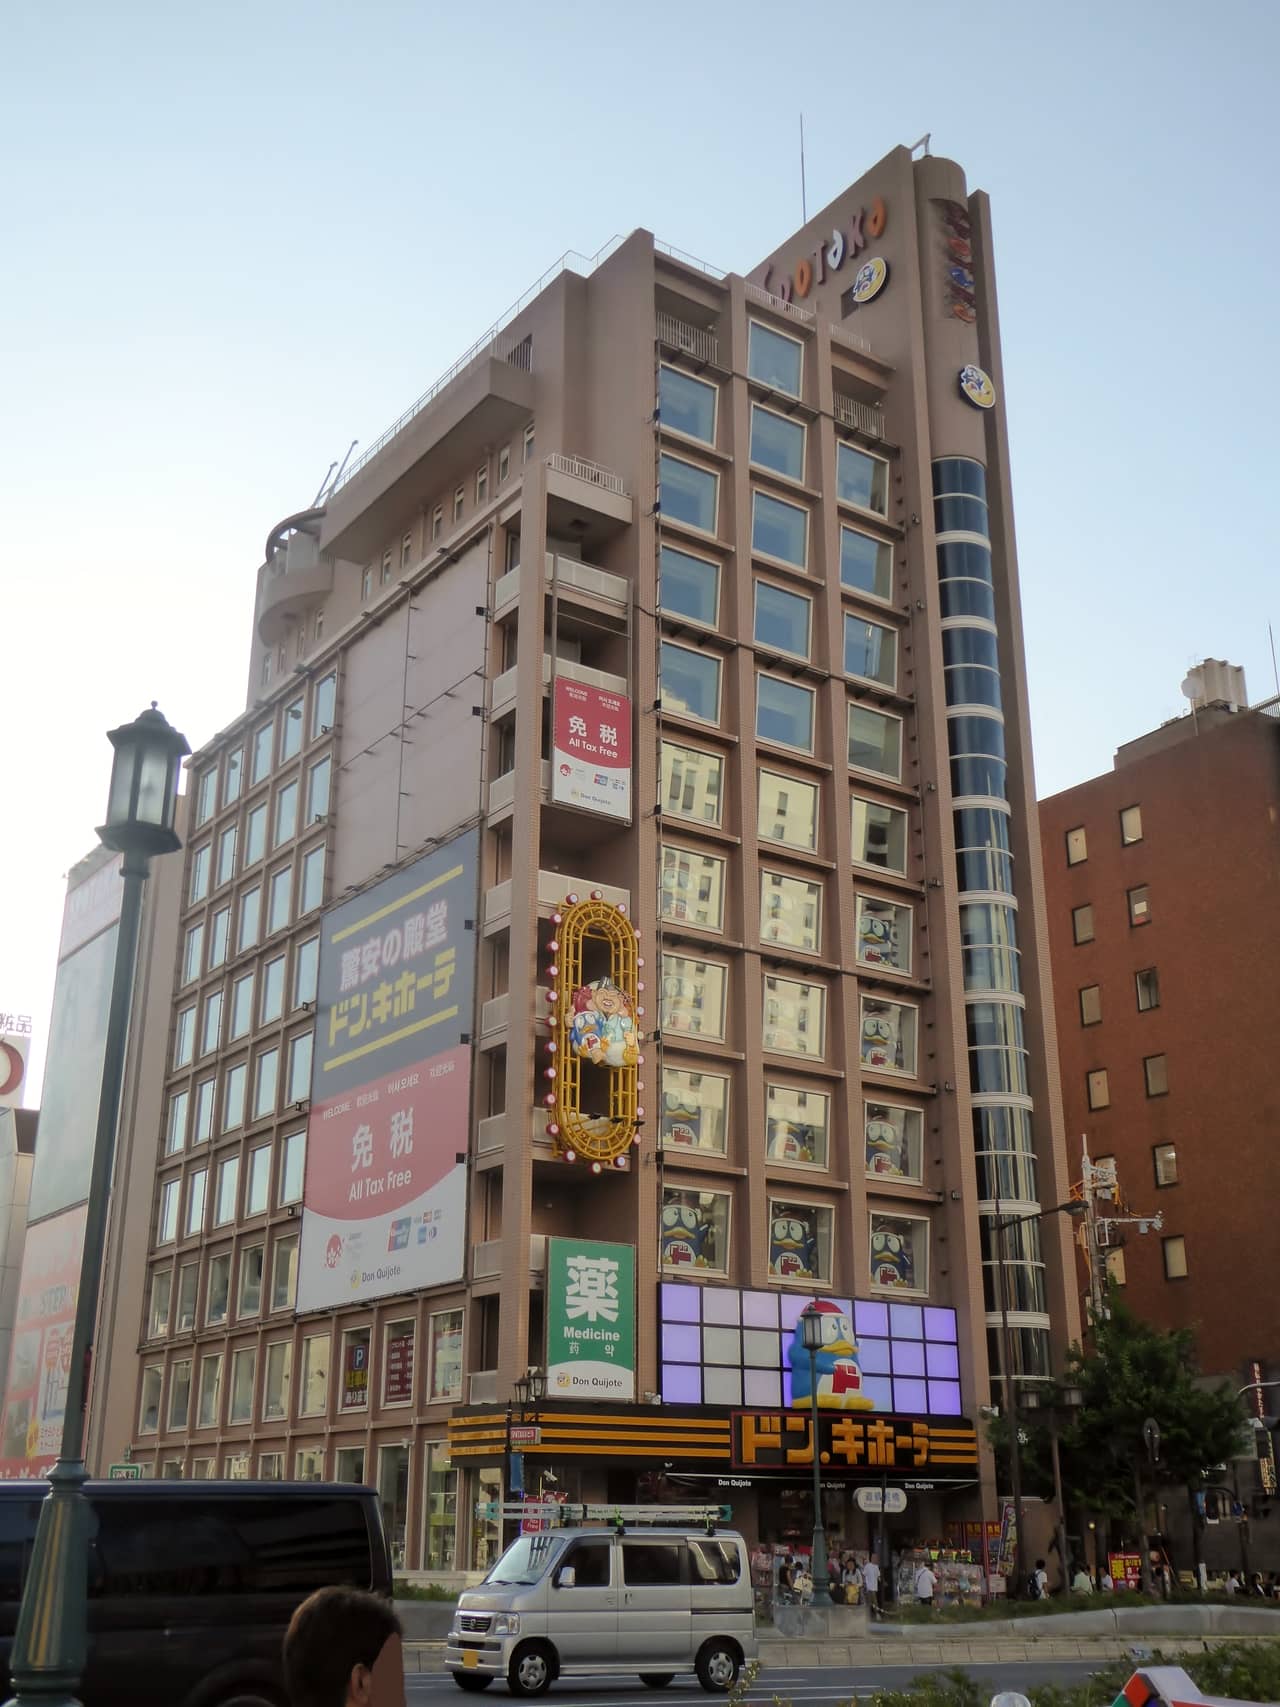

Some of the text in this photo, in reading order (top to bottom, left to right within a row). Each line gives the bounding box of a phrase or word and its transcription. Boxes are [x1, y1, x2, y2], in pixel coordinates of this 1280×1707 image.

[569, 737, 618, 759] All Tax Free
[340, 900, 449, 992] 驚安の殿堂
[349, 1169, 412, 1202] All Tax Free
[362, 1265, 401, 1282] Don Quijote
[565, 1255, 619, 1323] 薬
[563, 1326, 621, 1342] Medicine
[572, 1376, 623, 1389] Don Quijote
[718, 1479, 752, 1488] Don Quijote
